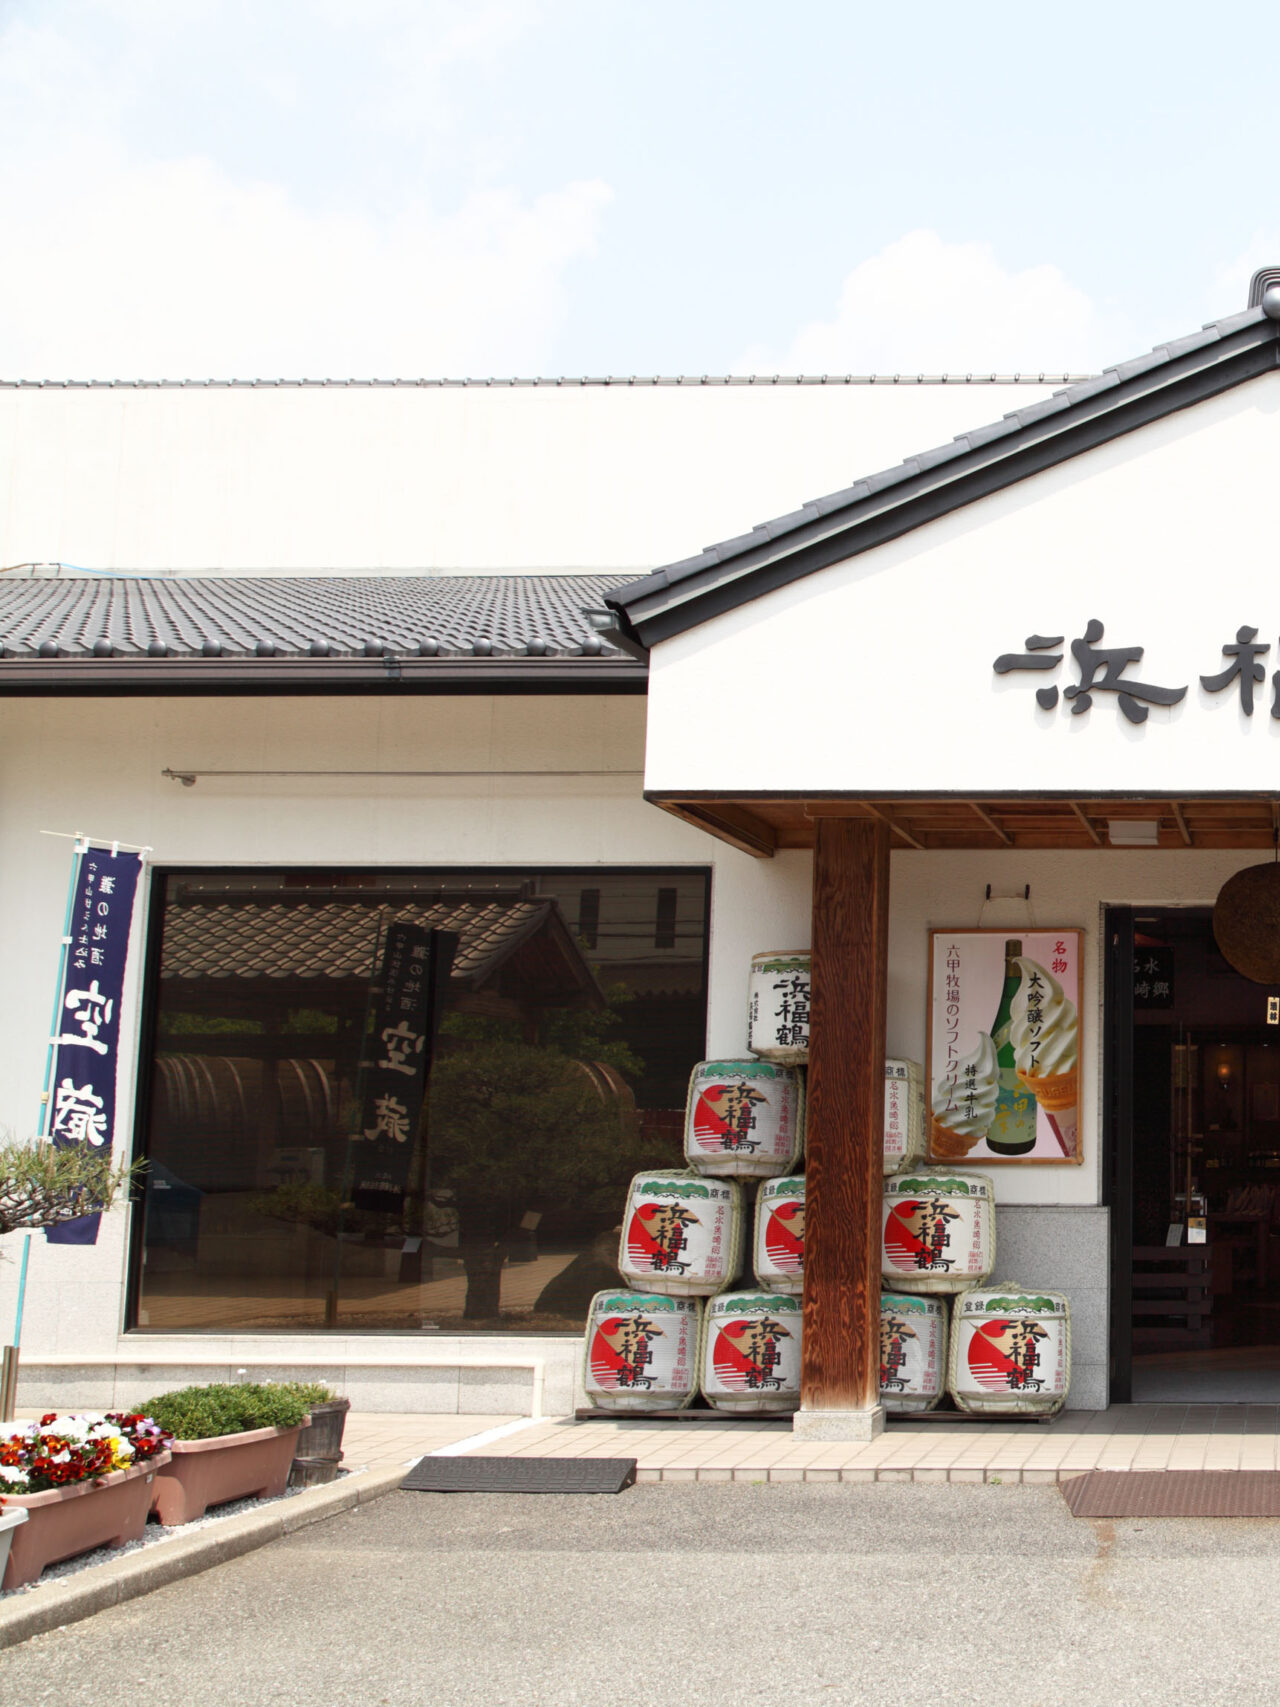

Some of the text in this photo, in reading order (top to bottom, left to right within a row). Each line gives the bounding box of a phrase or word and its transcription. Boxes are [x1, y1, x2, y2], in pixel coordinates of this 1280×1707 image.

[1052, 940, 1068, 973] 名物
[773, 975, 811, 1048] 浜福鶴
[945, 945, 960, 1112] 六甲牧場のソフトクリーム
[1027, 972, 1044, 1068] 大吟醸ソフト
[718, 1082, 767, 1154] 浜福鶴
[964, 1065, 978, 1119] 特選牛乳
[650, 1202, 699, 1276] 浜福鶴
[911, 1198, 960, 1273] 浜福鶴
[614, 1314, 664, 1390] 浜福鶴
[740, 1316, 791, 1391] 浜福鶴
[1000, 1317, 1048, 1393] 浜福鶴
